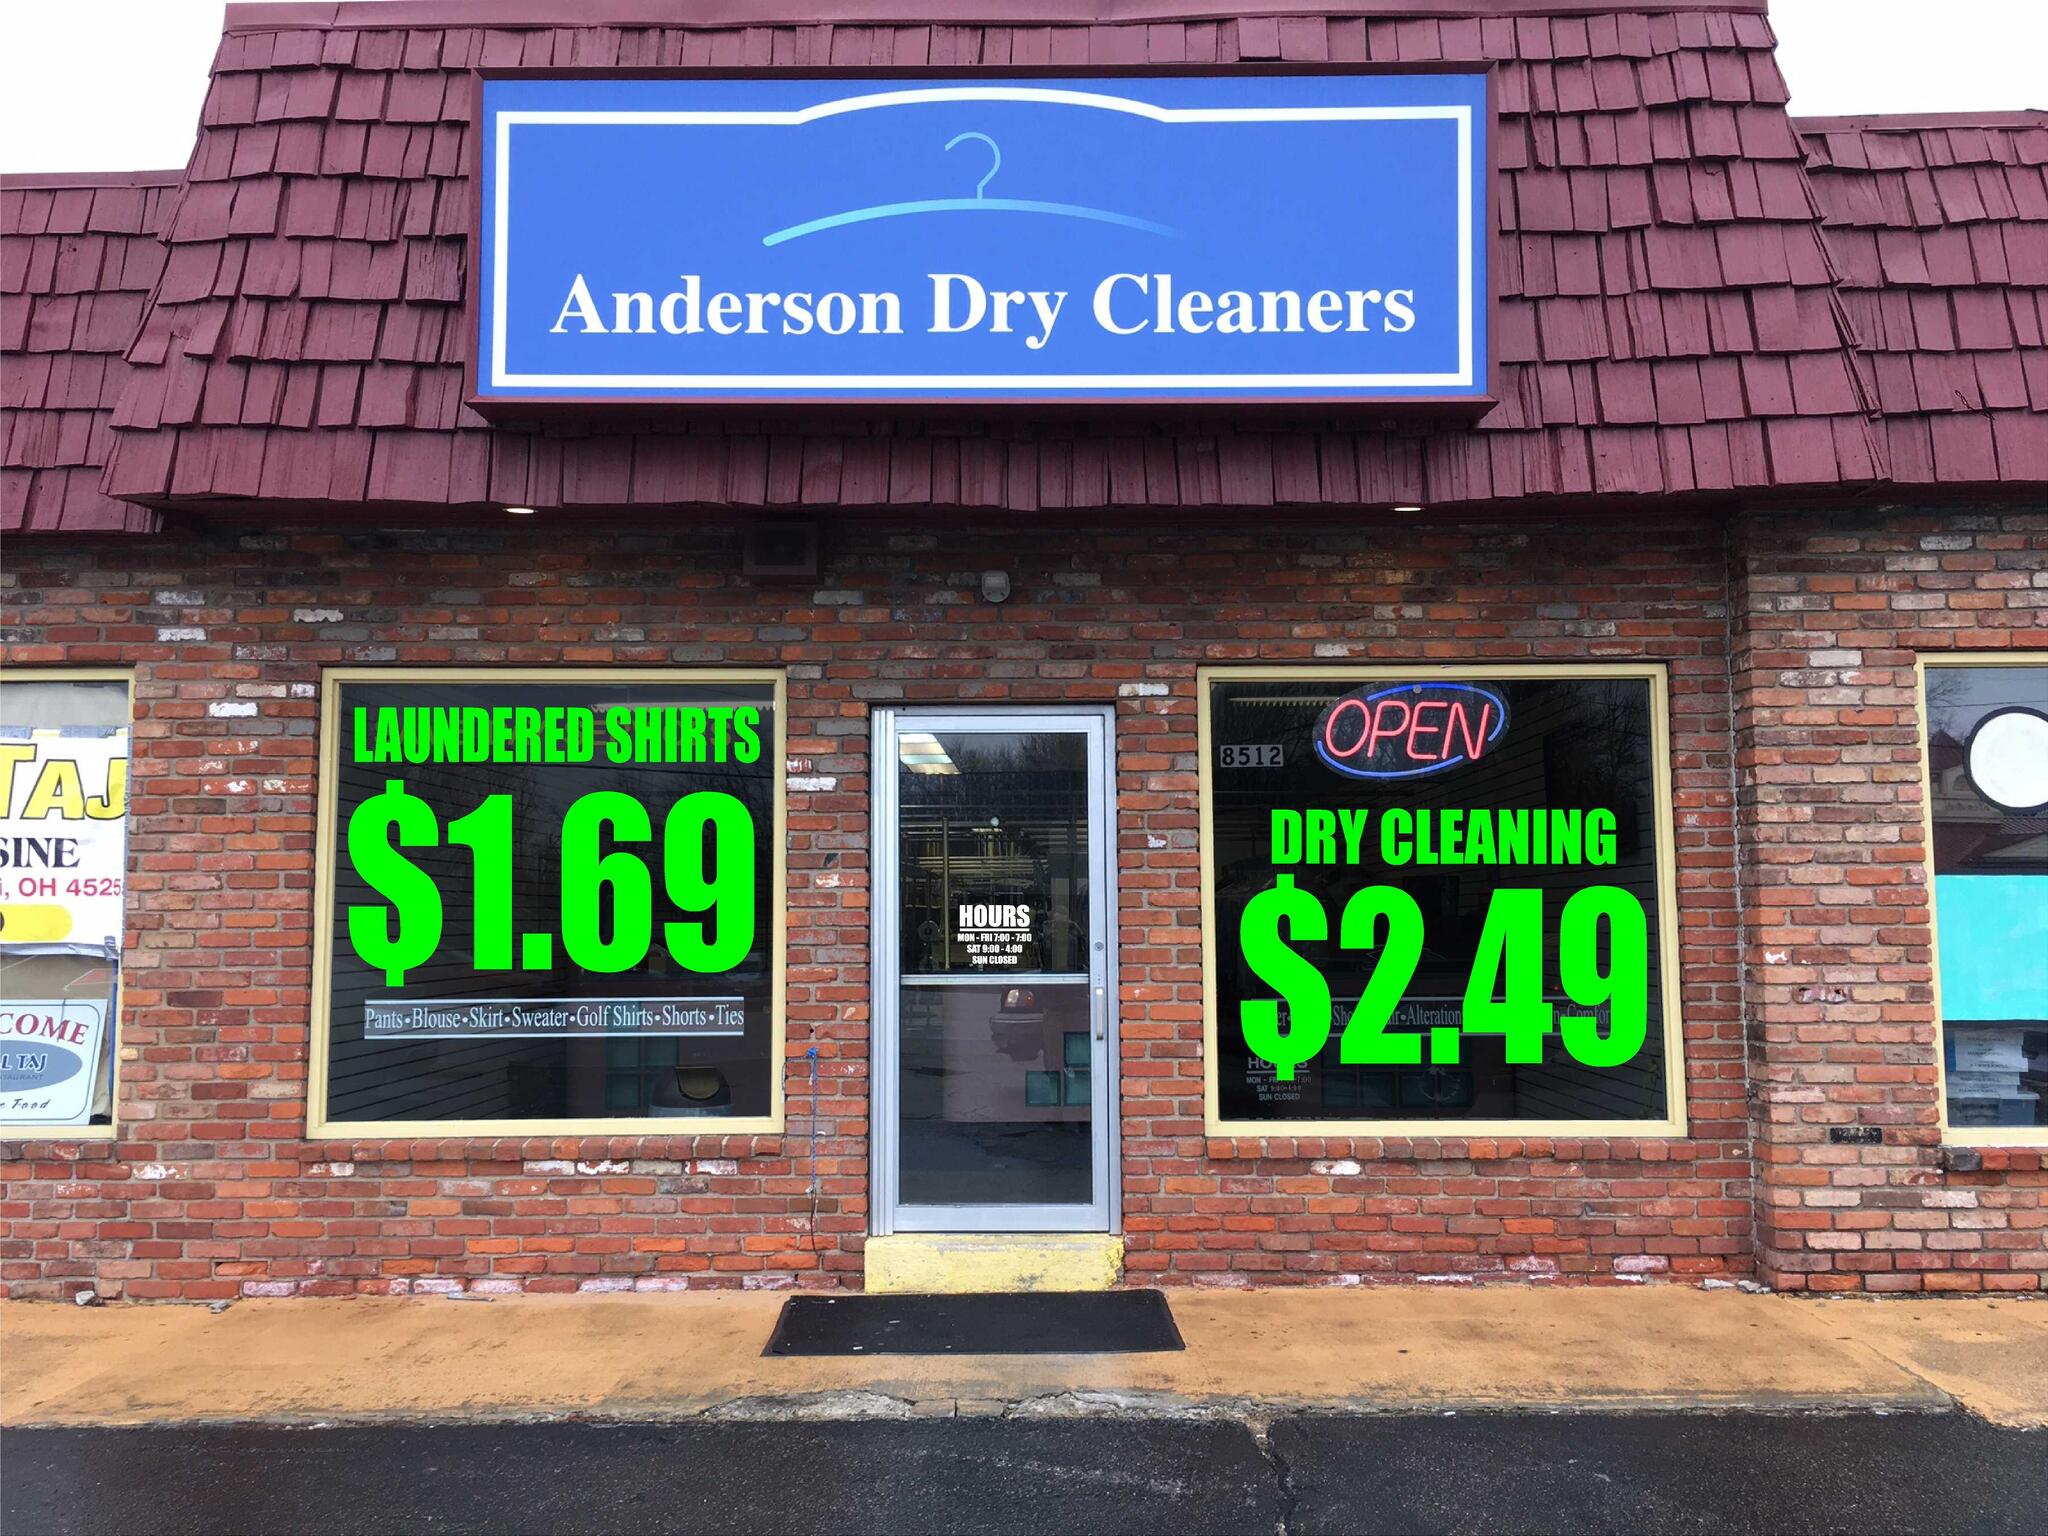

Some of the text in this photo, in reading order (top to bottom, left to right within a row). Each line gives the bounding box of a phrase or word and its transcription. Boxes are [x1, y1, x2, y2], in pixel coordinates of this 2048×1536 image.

[549, 273, 1416, 350] Anderson Dry Cleaners
[1325, 698, 1490, 760] OPEN
[1222, 746, 1282, 766] 8512
[18, 877, 56, 897] OH
[959, 904, 1031, 928] HOURS
[957, 933, 975, 942] MON
[980, 933, 993, 942] FRI
[993, 933, 1010, 942] 7:00
[1015, 933, 1032, 942] 7:00
[966, 944, 982, 953] SAT
[982, 944, 1000, 953] 9:00
[1005, 944, 1023, 953] 4:00
[972, 955, 1018, 965] SUN CLOSED
[16, 1053, 48, 1073] TAJ
[12, 1098, 51, 1109] Food
